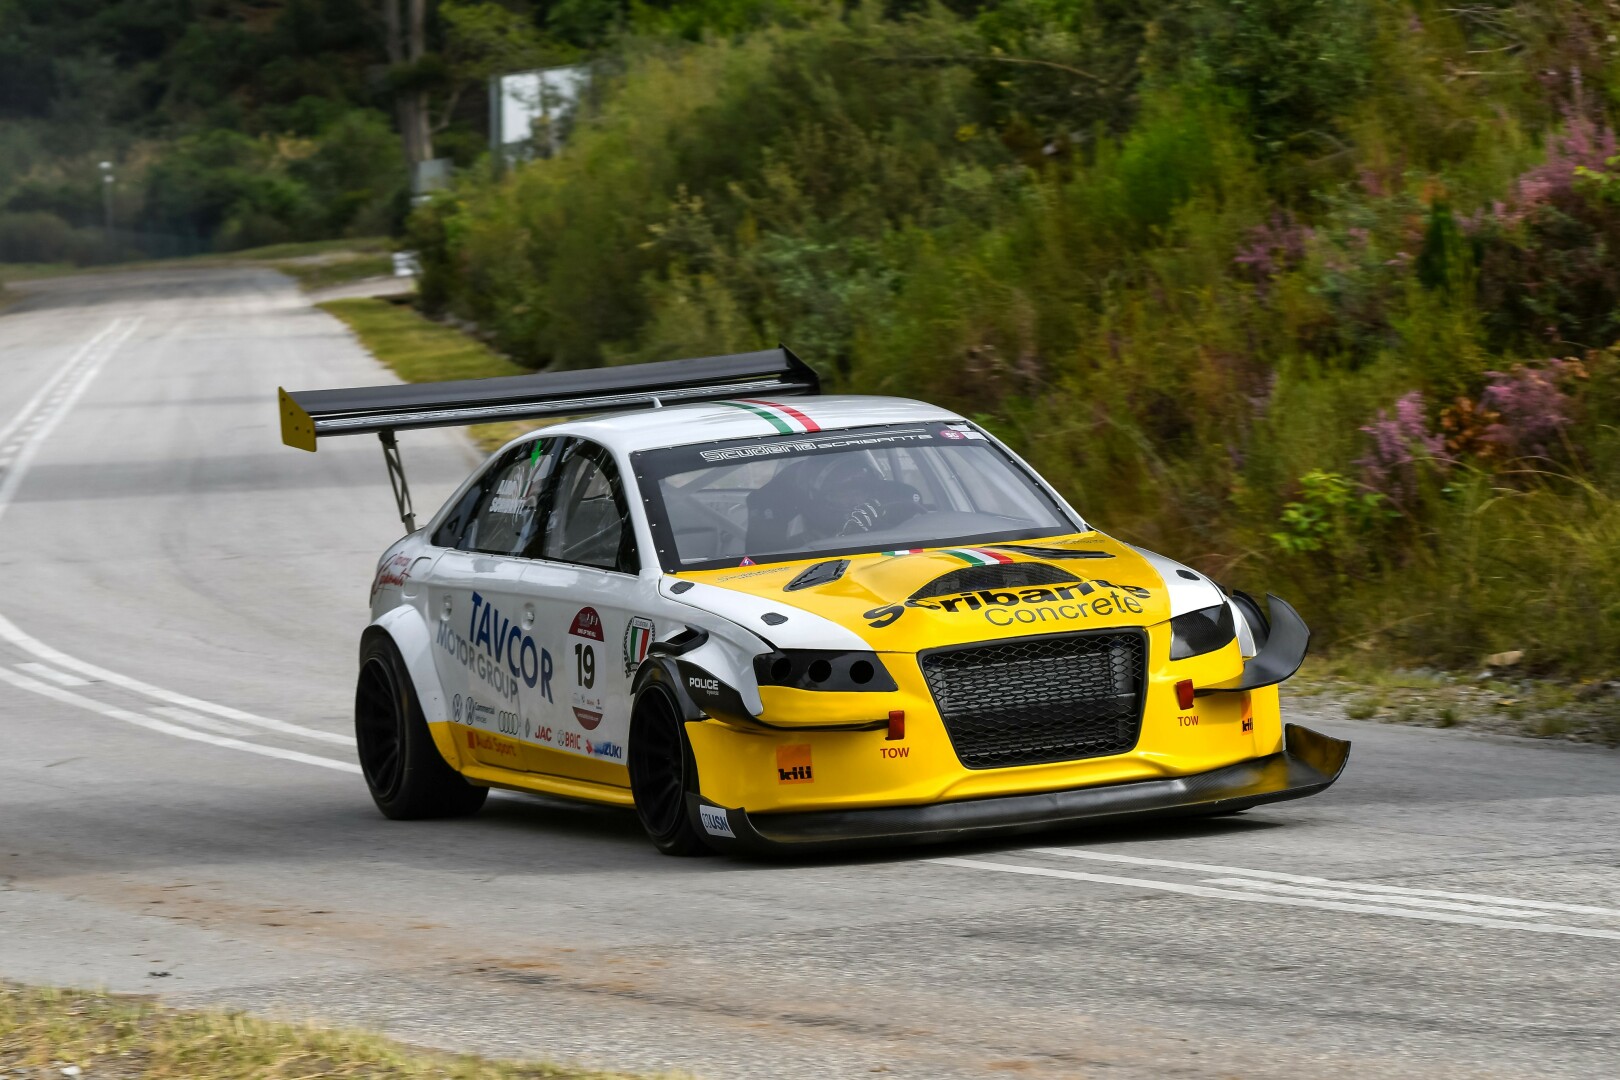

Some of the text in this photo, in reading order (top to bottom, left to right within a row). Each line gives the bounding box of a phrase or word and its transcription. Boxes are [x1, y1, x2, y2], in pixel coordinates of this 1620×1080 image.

[863, 580, 1151, 629] Scribante
[985, 590, 1144, 626] Concrete
[470, 591, 553, 704] TAVCOR
[437, 619, 519, 703] MOTOR GROUP
[575, 643, 595, 690] 19
[690, 677, 719, 690] POLICE
[1177, 716, 1199, 726] TOW
[475, 733, 517, 756] Audi Sport
[535, 726, 552, 741] JAC
[565, 732, 581, 750] BAIC
[880, 747, 910, 759] TOW
